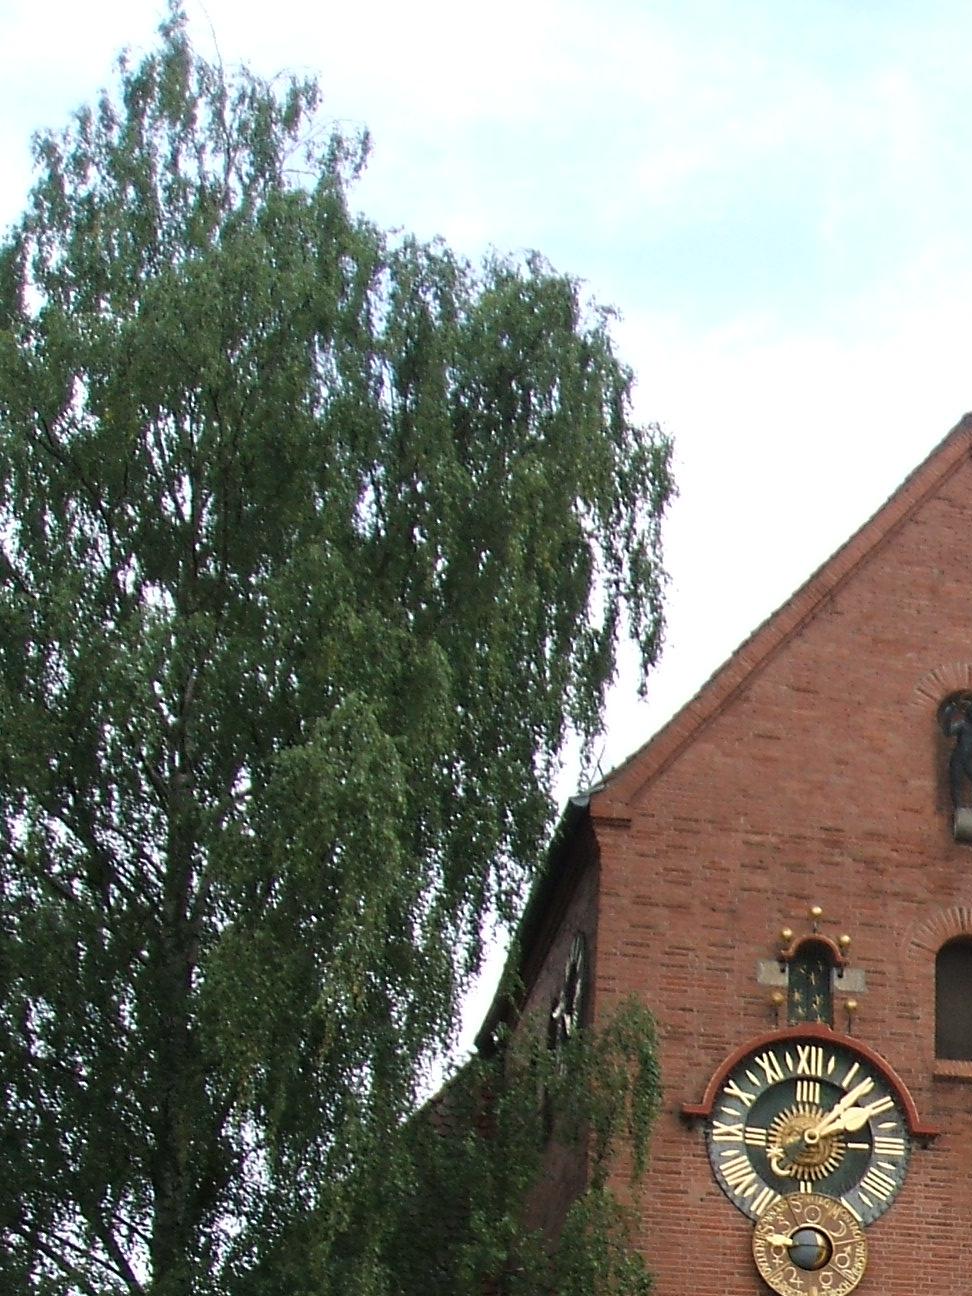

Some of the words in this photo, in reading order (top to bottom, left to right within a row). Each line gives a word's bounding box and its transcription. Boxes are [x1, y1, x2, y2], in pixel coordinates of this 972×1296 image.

[755, 1050, 784, 1084] XI
[797, 1045, 823, 1077] XII
[723, 1079, 756, 1107] X
[712, 1120, 744, 1141] IX
[874, 1136, 905, 1155] III
